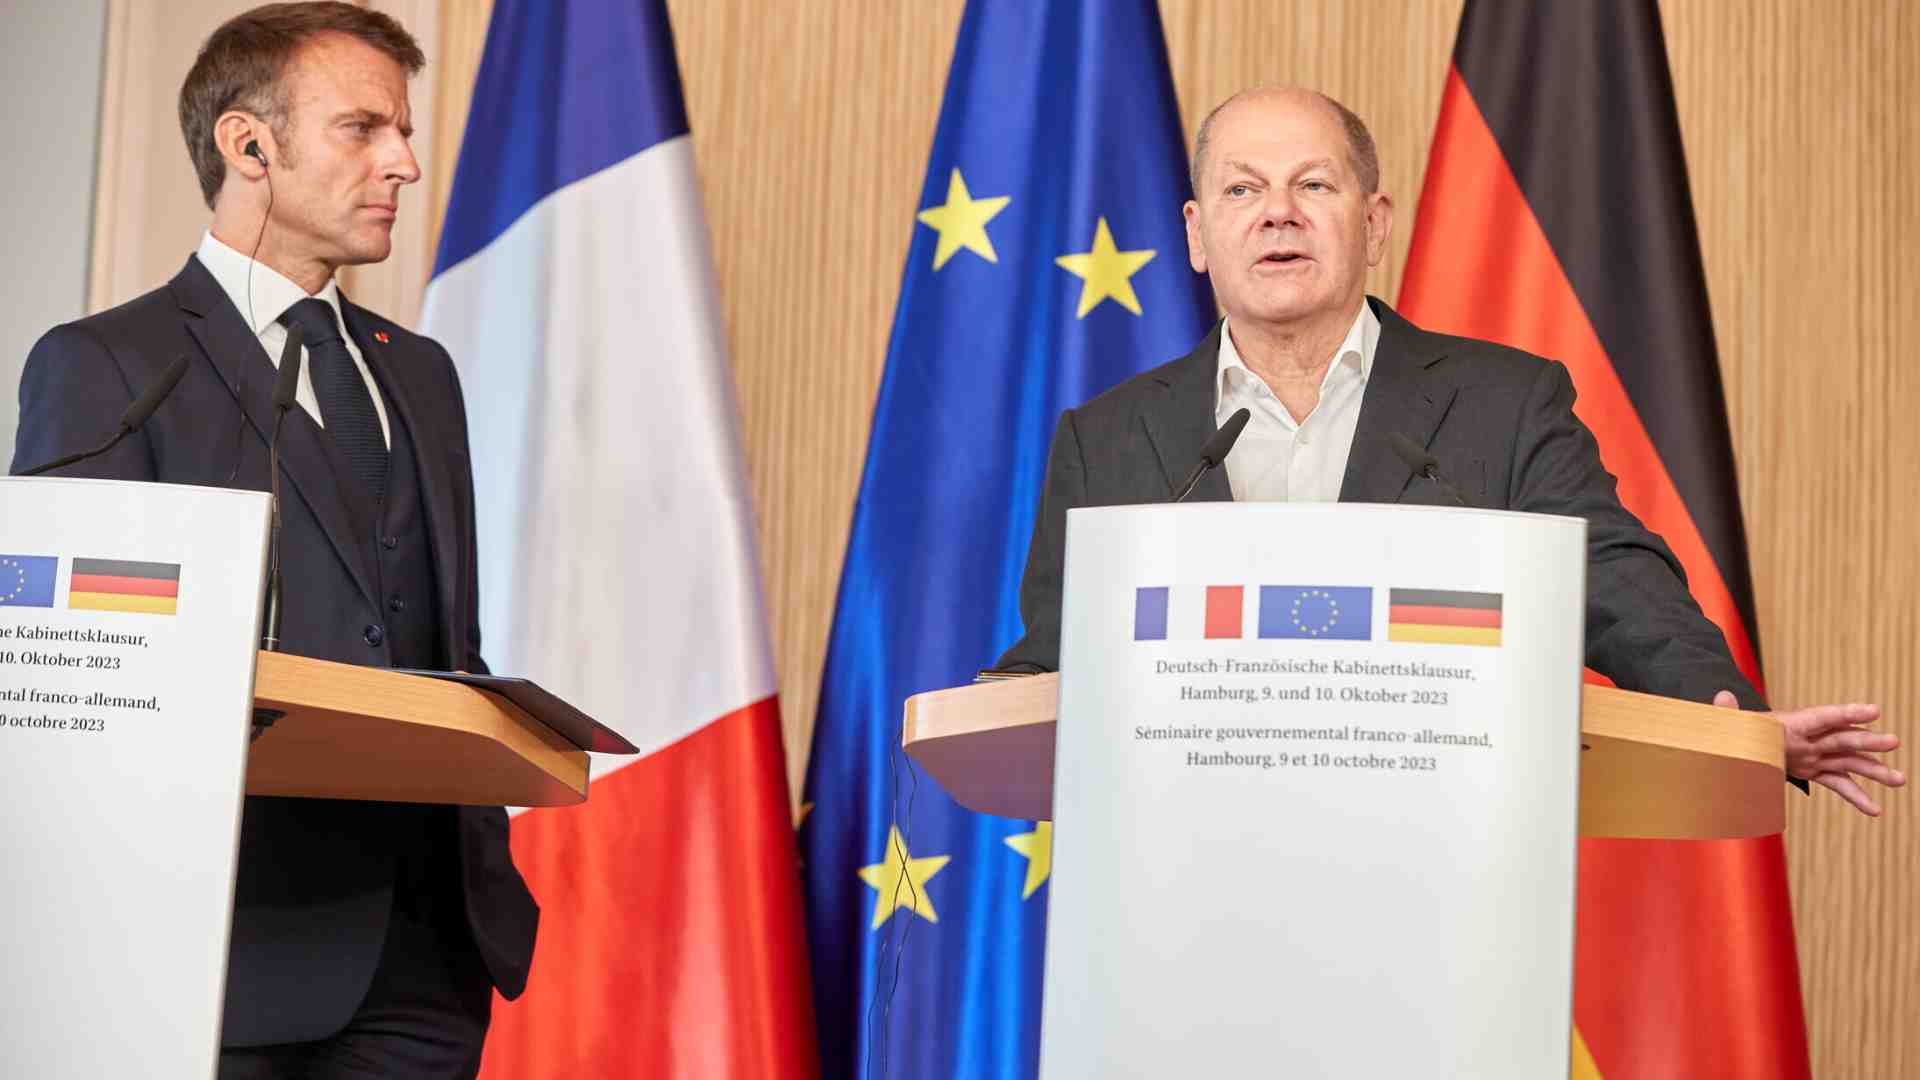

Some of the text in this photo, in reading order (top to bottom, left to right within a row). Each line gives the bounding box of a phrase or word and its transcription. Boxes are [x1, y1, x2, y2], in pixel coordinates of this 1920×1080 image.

[15, 624, 149, 648] Kabinettsklausur,
[20, 651, 83, 668] Oktober
[85, 655, 121, 669] 2023
[1156, 658, 1477, 681] Deutsch-Französische Kabinettsklausur,
[29, 688, 161, 713] franco-allemand,
[1180, 685, 1449, 705] Hamburg, 9. und 10. Oktober 2023
[9, 715, 67, 730] octobre
[69, 717, 105, 732] 2023
[1135, 724, 1494, 748] Séminaire gouvernemental franco-allemand,
[1186, 751, 1437, 771] Hambourg, 9 et 10 octobre 2023
